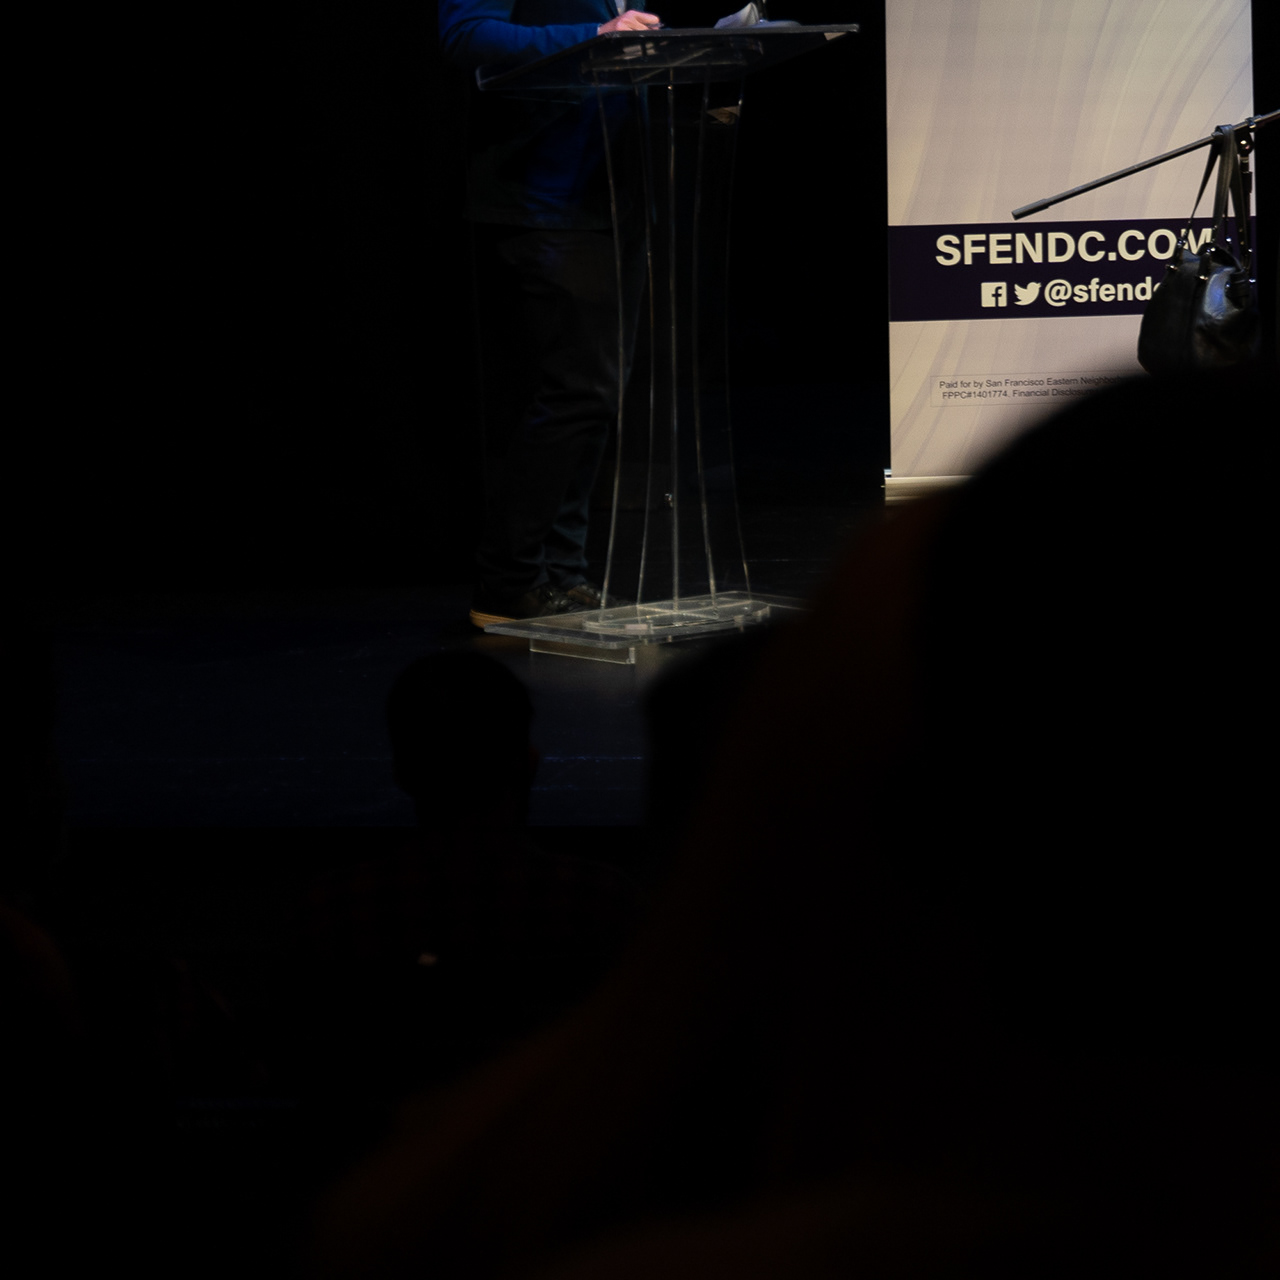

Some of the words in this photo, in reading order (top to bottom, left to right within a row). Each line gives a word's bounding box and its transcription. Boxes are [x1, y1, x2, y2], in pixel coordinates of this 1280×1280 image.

[1044, 275, 1161, 307] @sfend
[939, 380, 958, 389] Paid
[960, 380, 972, 388] for
[973, 380, 983, 389] by
[985, 379, 1003, 387] San
[1004, 378, 1044, 387] Francisco
[1046, 377, 1079, 386] Eastern
[1012, 388, 1050, 397] Financial
